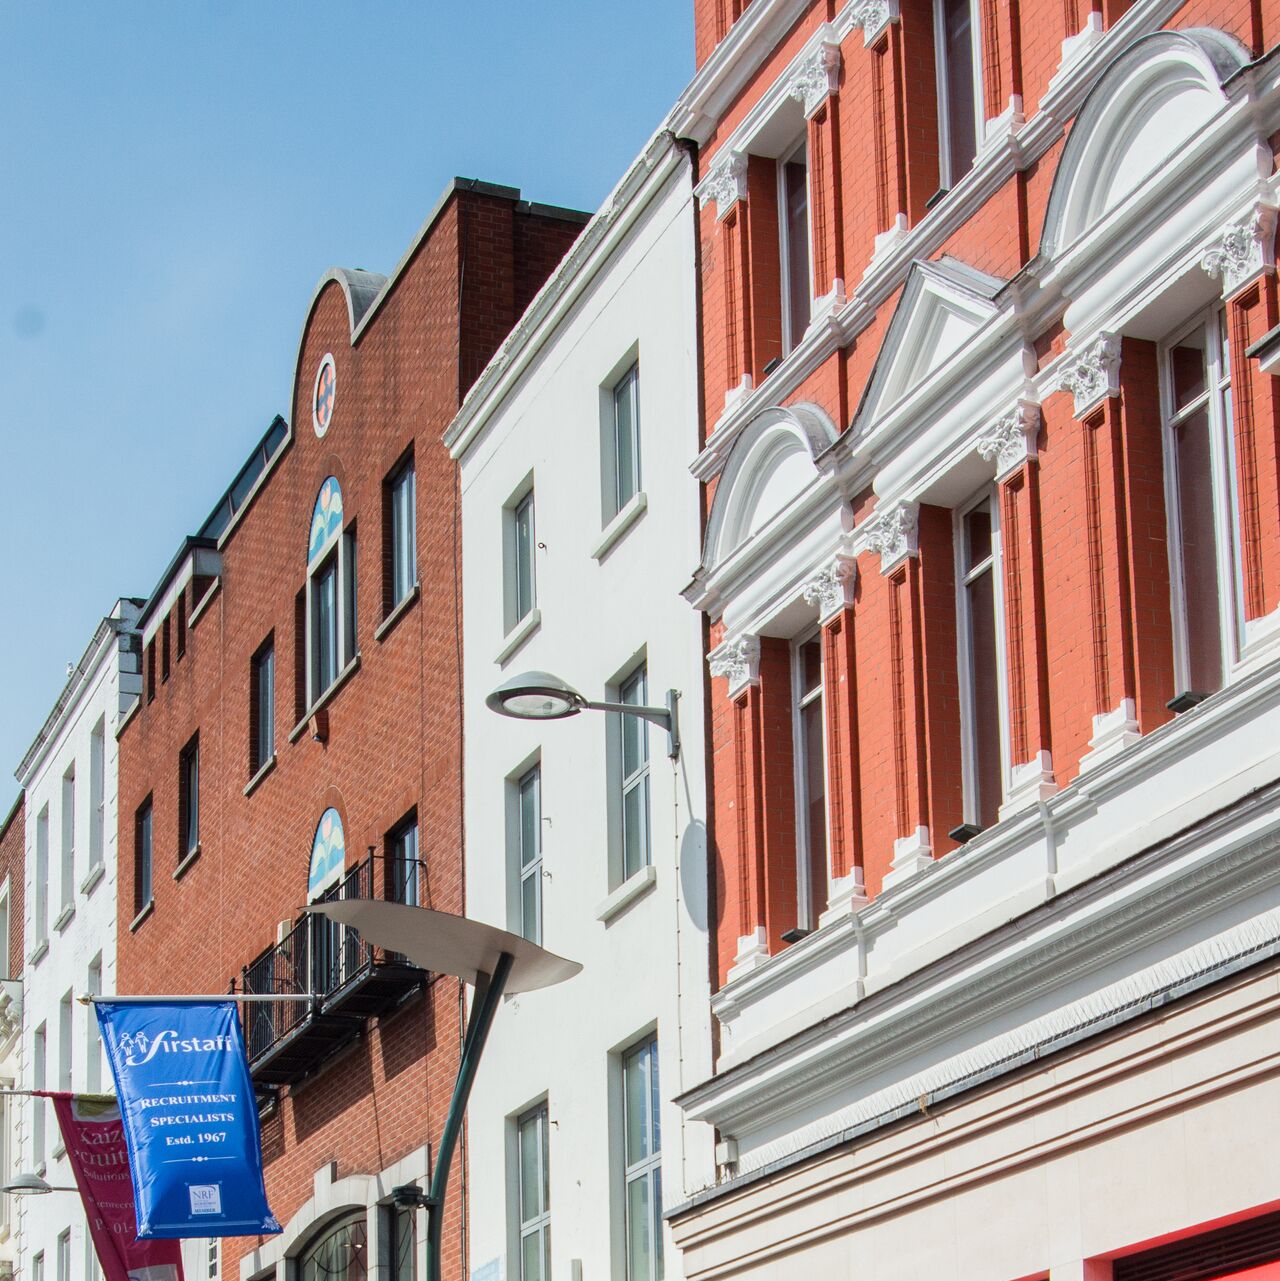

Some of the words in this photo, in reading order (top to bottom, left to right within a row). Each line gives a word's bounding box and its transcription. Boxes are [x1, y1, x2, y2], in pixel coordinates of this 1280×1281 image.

[141, 1094, 237, 1109] RECRUITMENT
[151, 1113, 235, 1127] SPECIALISTS
[166, 1136, 195, 1146] Estd.
[197, 1132, 226, 1143] 1967
